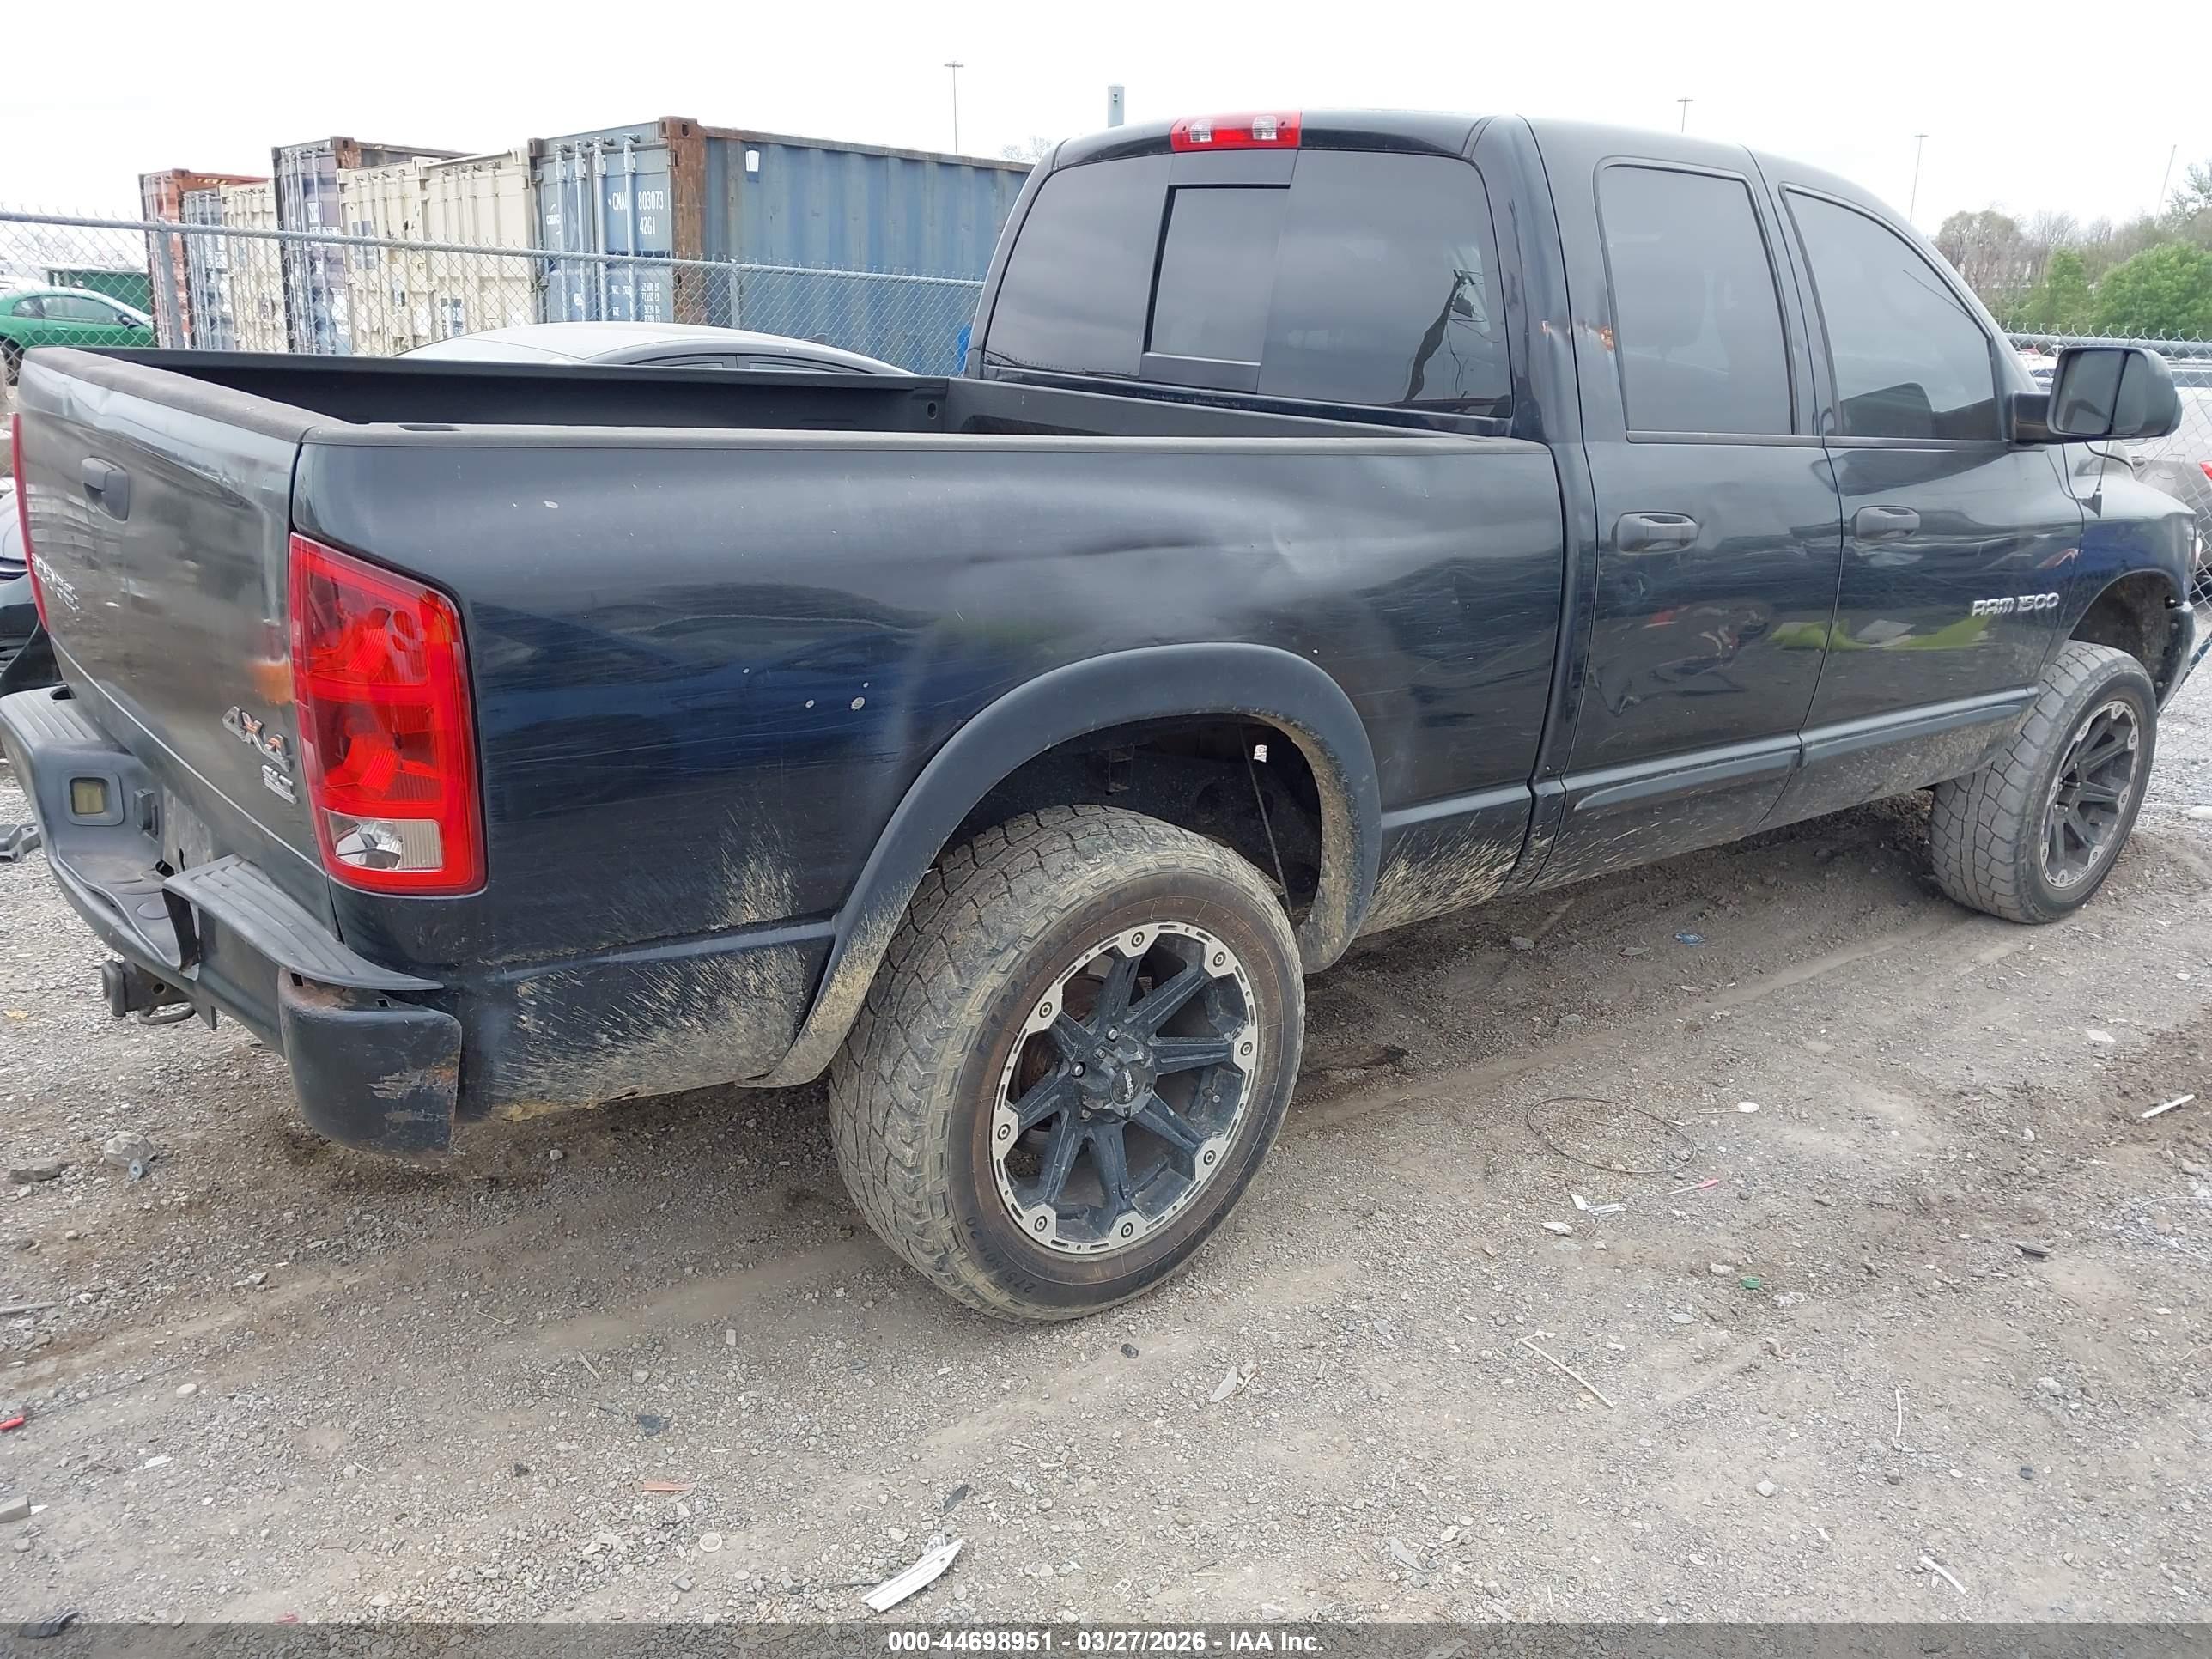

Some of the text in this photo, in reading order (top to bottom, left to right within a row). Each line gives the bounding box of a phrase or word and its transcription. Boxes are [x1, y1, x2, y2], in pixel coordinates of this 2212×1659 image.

[638, 191, 664, 210] 803073
[639, 216, 656, 235] 42G1
[1972, 592, 2060, 617] RAM 1500
